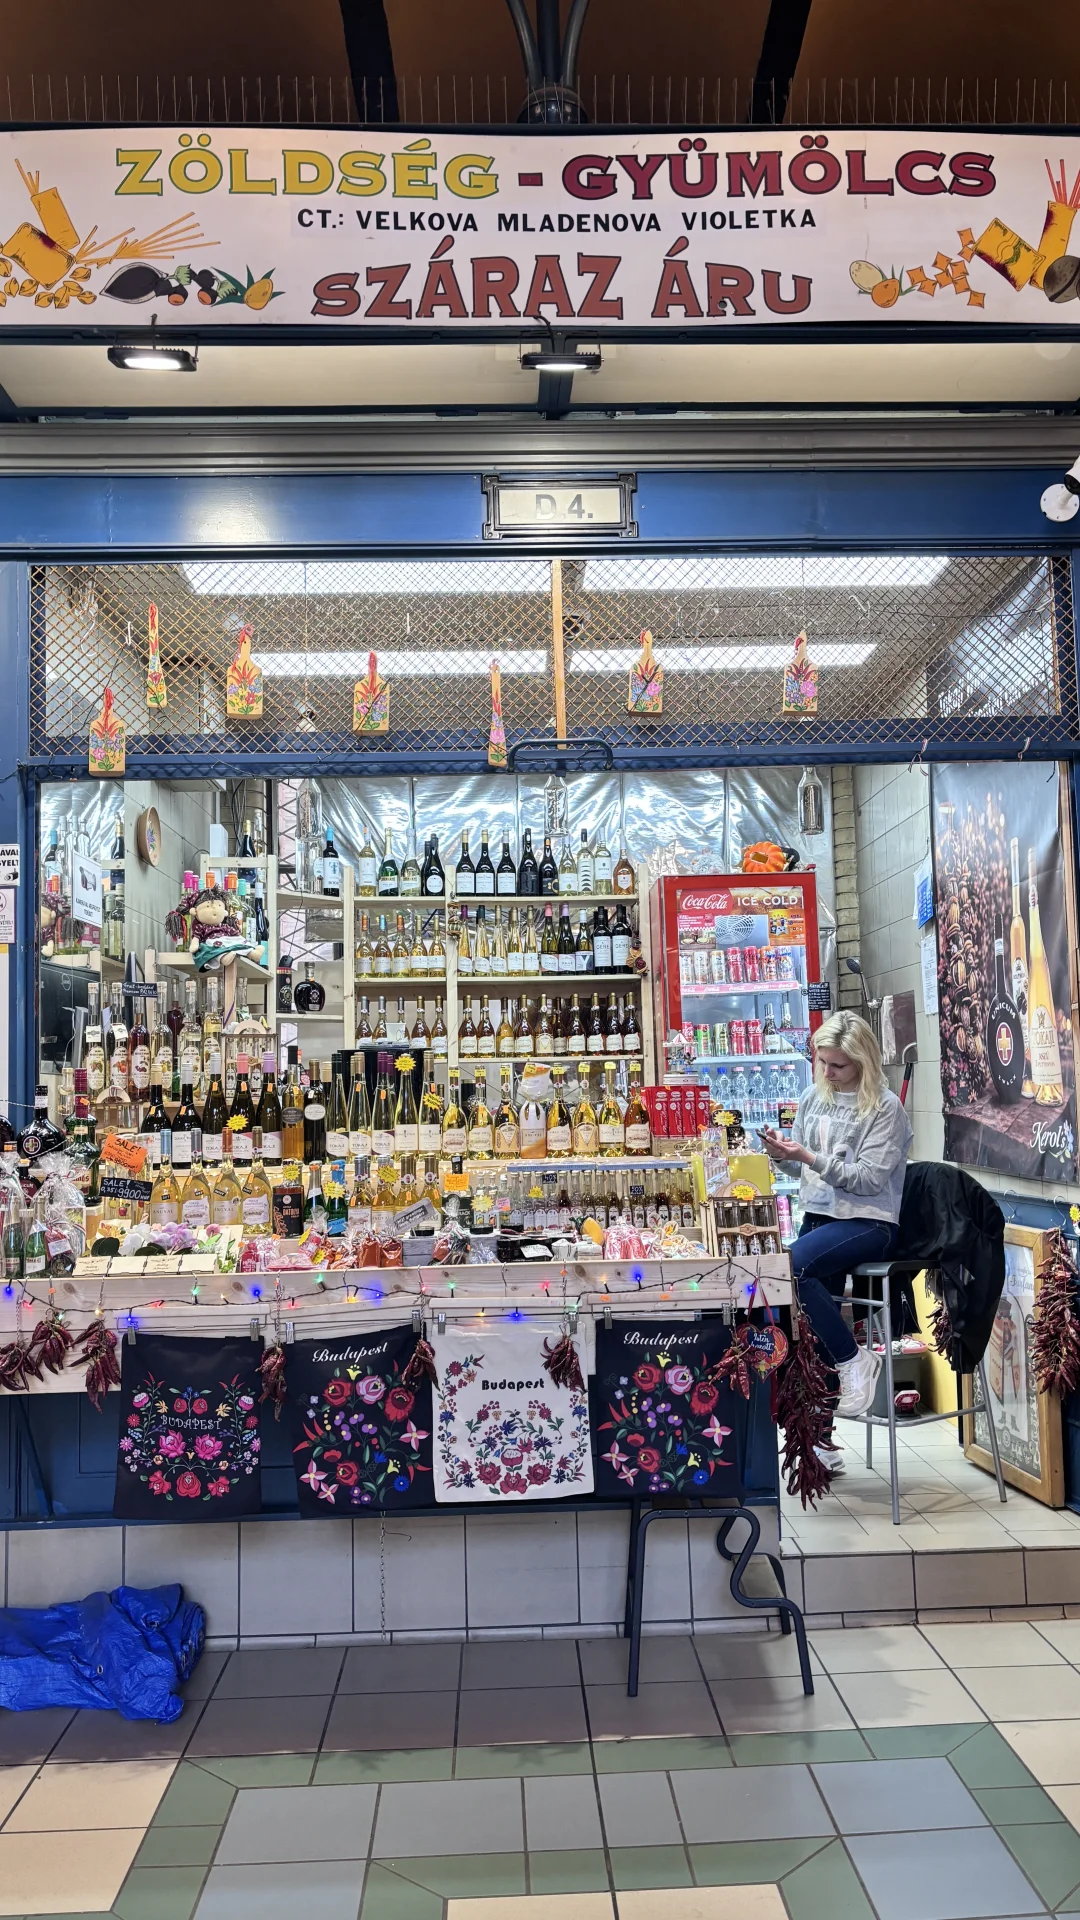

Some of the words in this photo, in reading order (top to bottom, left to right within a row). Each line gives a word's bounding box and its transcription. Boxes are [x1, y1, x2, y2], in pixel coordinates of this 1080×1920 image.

[114, 133, 499, 200] ZÖLDSÉG
[562, 137, 996, 200] GYÜMÖLCS
[297, 209, 344, 229] CT.:
[356, 210, 479, 231] VELKOVA
[498, 212, 661, 232] MLADENOVA
[682, 208, 817, 229] VIOLETKA
[311, 235, 624, 319] SZÁRAZ
[651, 236, 812, 318] ÁRU
[682, 894, 731, 910] Coca-Cola
[738, 896, 758, 906] ICE
[763, 896, 798, 905] COLD
[991, 1001, 1016, 1020] UNICUM
[1030, 1121, 1067, 1154] Kerol's
[115, 1139, 141, 1155] SALE!
[104, 1179, 131, 1189] SALE!
[117, 1187, 141, 1199] 9900
[623, 1331, 700, 1351] Budapest
[312, 1341, 388, 1364] Budapest
[481, 1377, 545, 1392] Budapest
[159, 1414, 222, 1431] BUDAPEST
